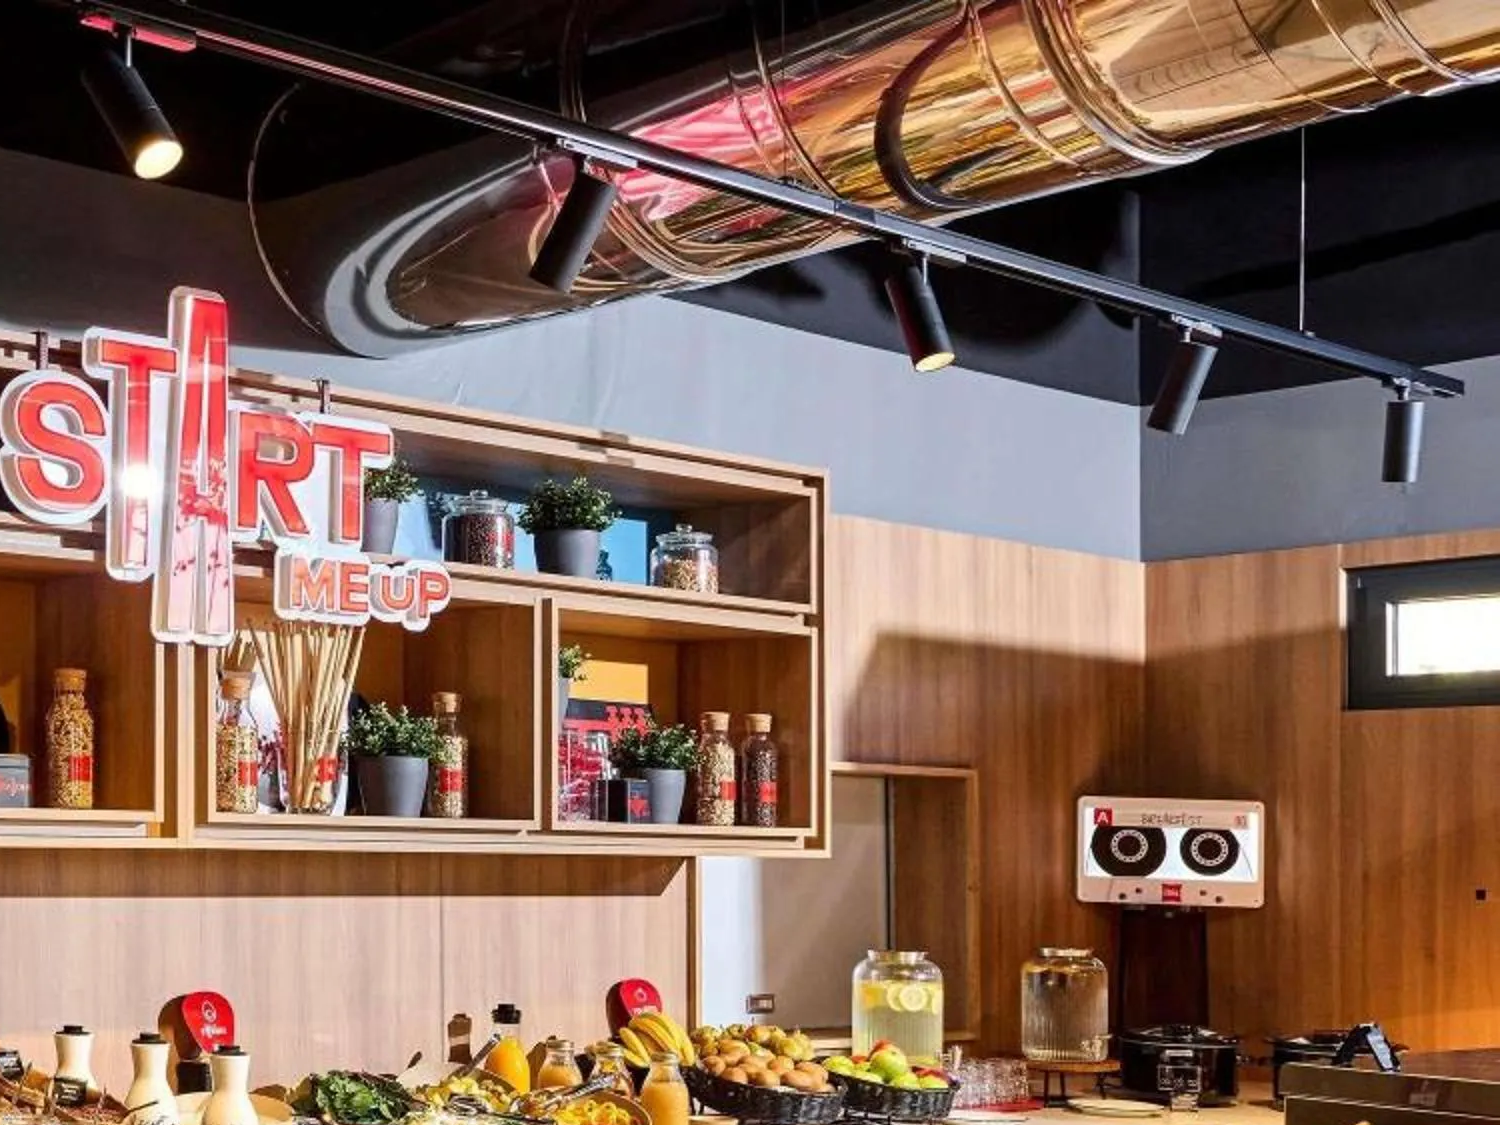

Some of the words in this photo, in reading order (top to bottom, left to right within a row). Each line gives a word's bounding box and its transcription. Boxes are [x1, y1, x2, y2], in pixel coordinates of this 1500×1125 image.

[274, 546, 370, 626] ME
[372, 562, 451, 631] UP
[1097, 812, 1109, 824] A
